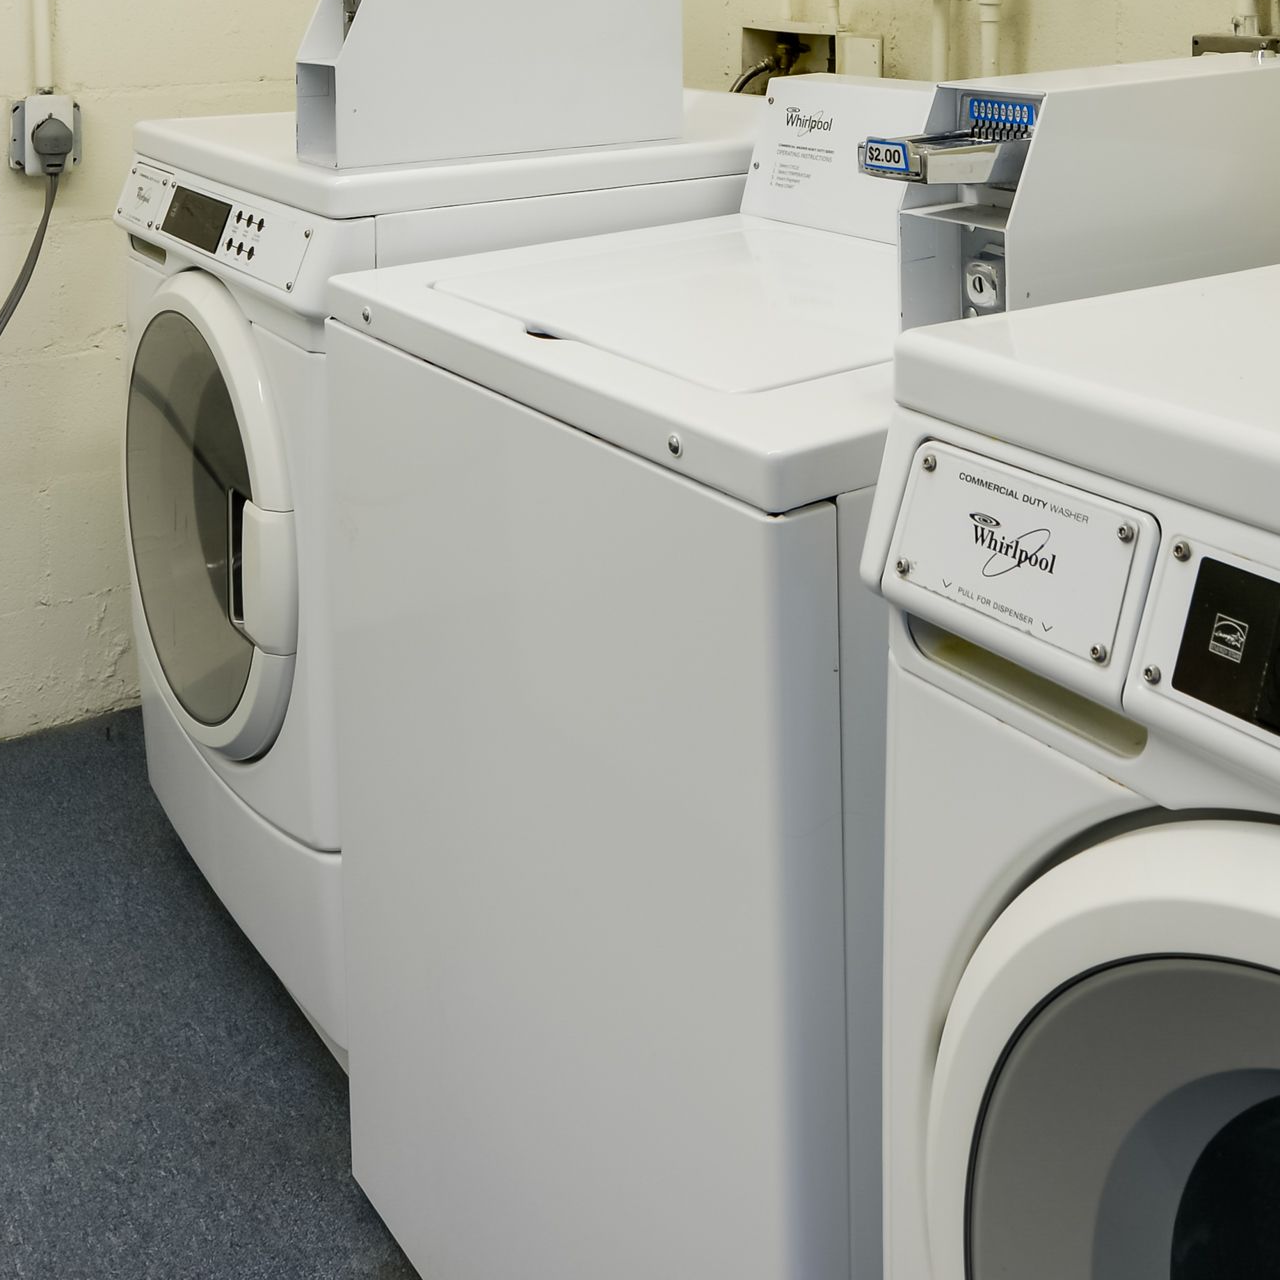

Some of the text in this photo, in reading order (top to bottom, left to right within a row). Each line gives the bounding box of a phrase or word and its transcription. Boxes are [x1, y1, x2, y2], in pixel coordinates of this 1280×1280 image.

[786, 113, 833, 133] Whirlpool
[868, 145, 900, 165] $2.00
[959, 472, 1089, 524] COMMERCIAL DUTY WASHER
[973, 524, 1056, 574] Whirlpool
[958, 586, 1034, 625] PULL FOR DISPENSER
